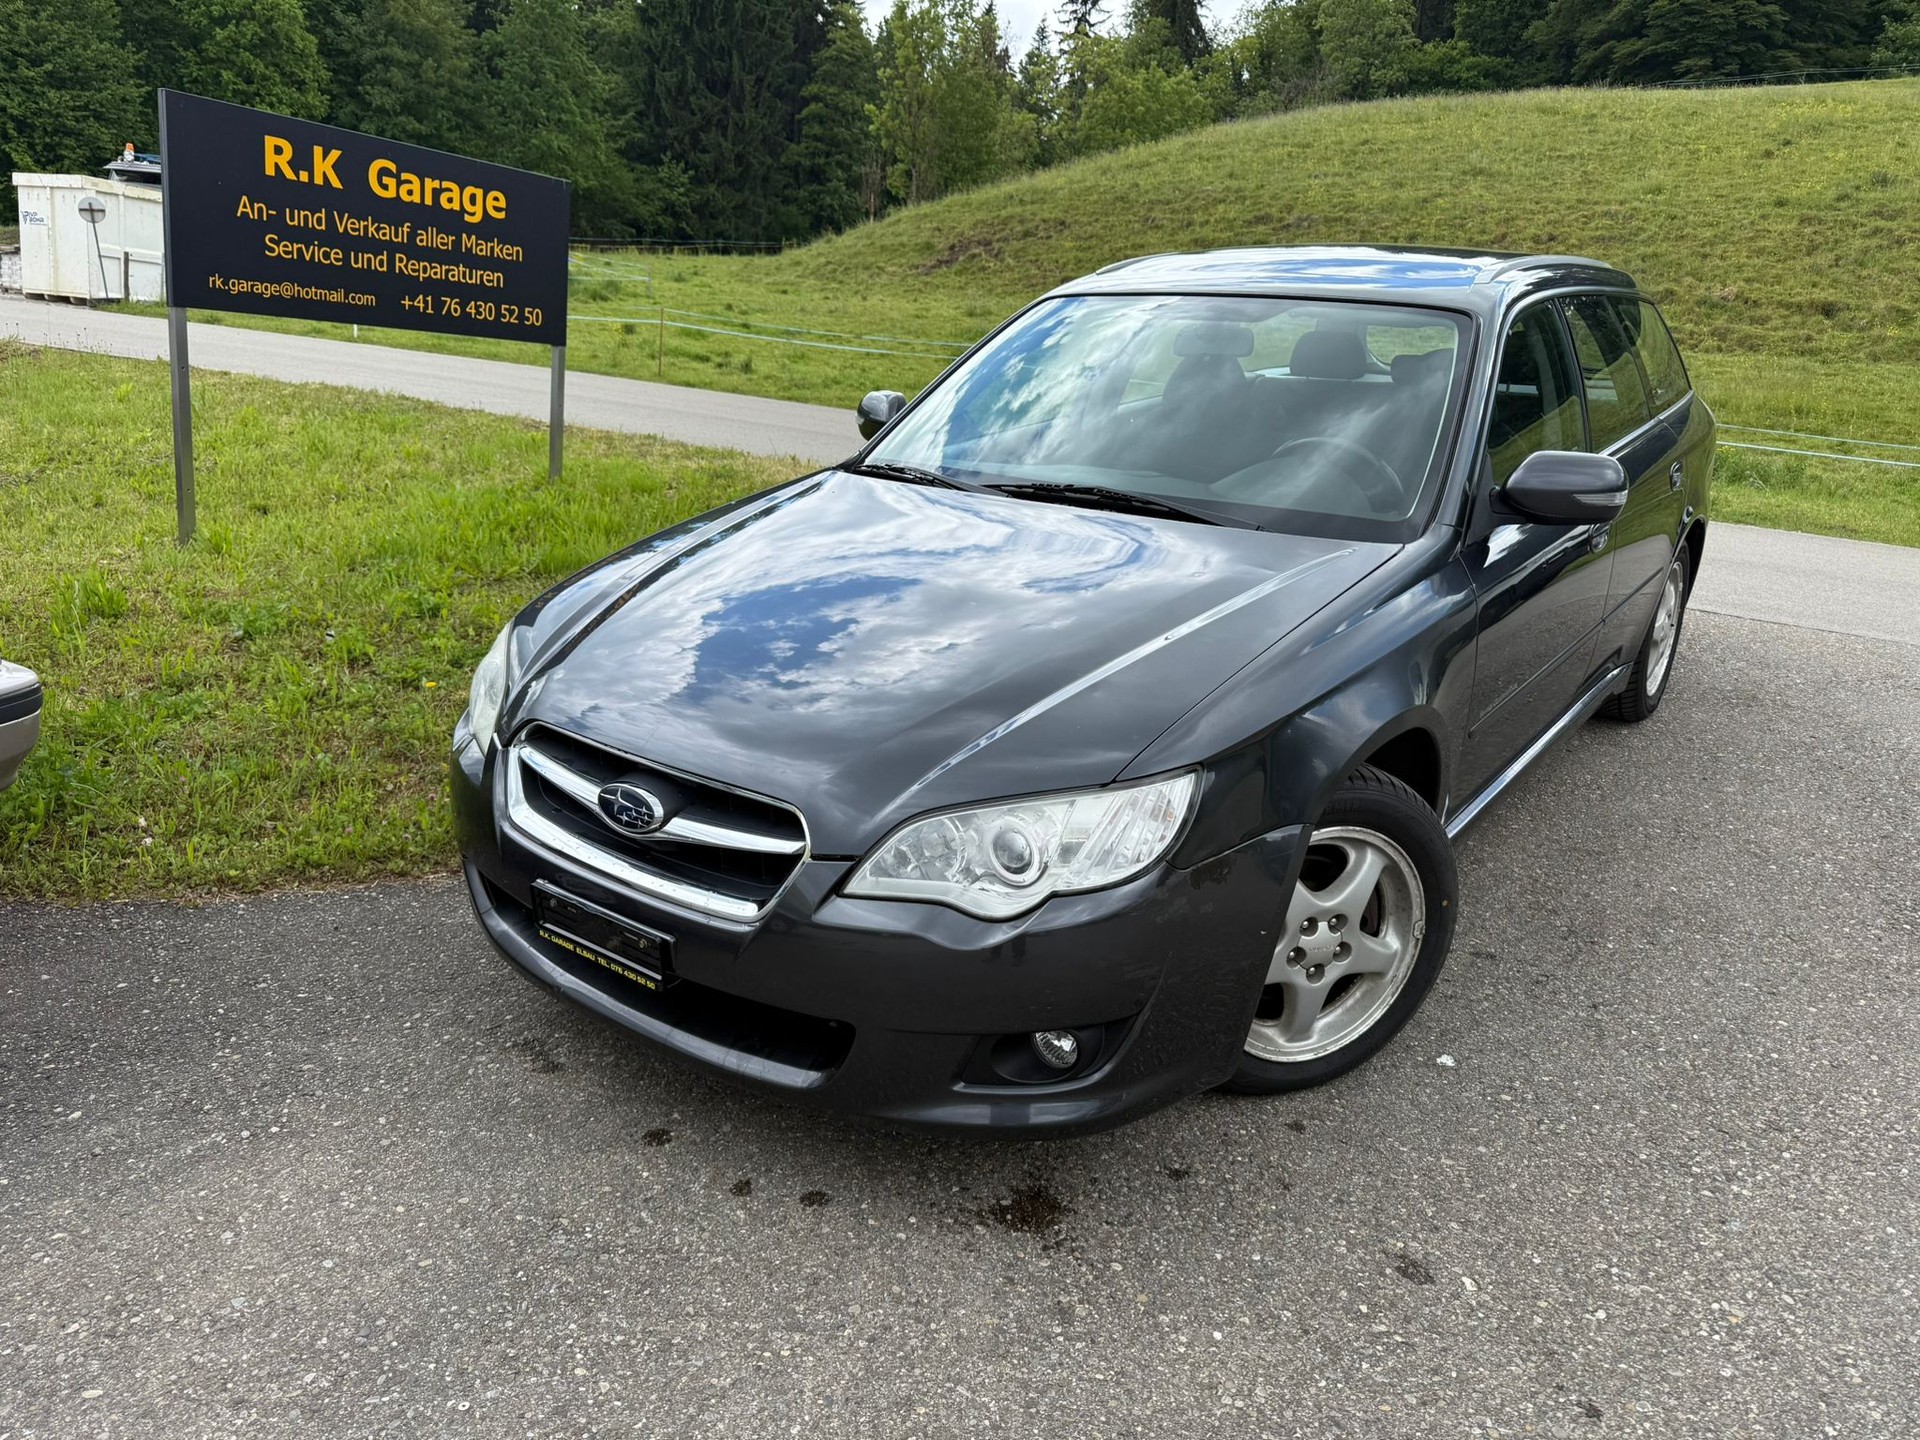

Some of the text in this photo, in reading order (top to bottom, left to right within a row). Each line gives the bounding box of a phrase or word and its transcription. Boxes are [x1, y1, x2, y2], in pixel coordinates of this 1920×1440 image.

[264, 134, 507, 224] R.K Garage
[236, 195, 523, 262] An- und Verkauf aller Marken
[264, 233, 504, 288] Service und Reparaturen
[208, 273, 543, 327] rk.garage@hotmail.com +41 76 430 52 50
[550, 935, 575, 952] GARAGE
[623, 970, 637, 981] 430
[637, 975, 647, 986] 52
[646, 980, 656, 990] 50
